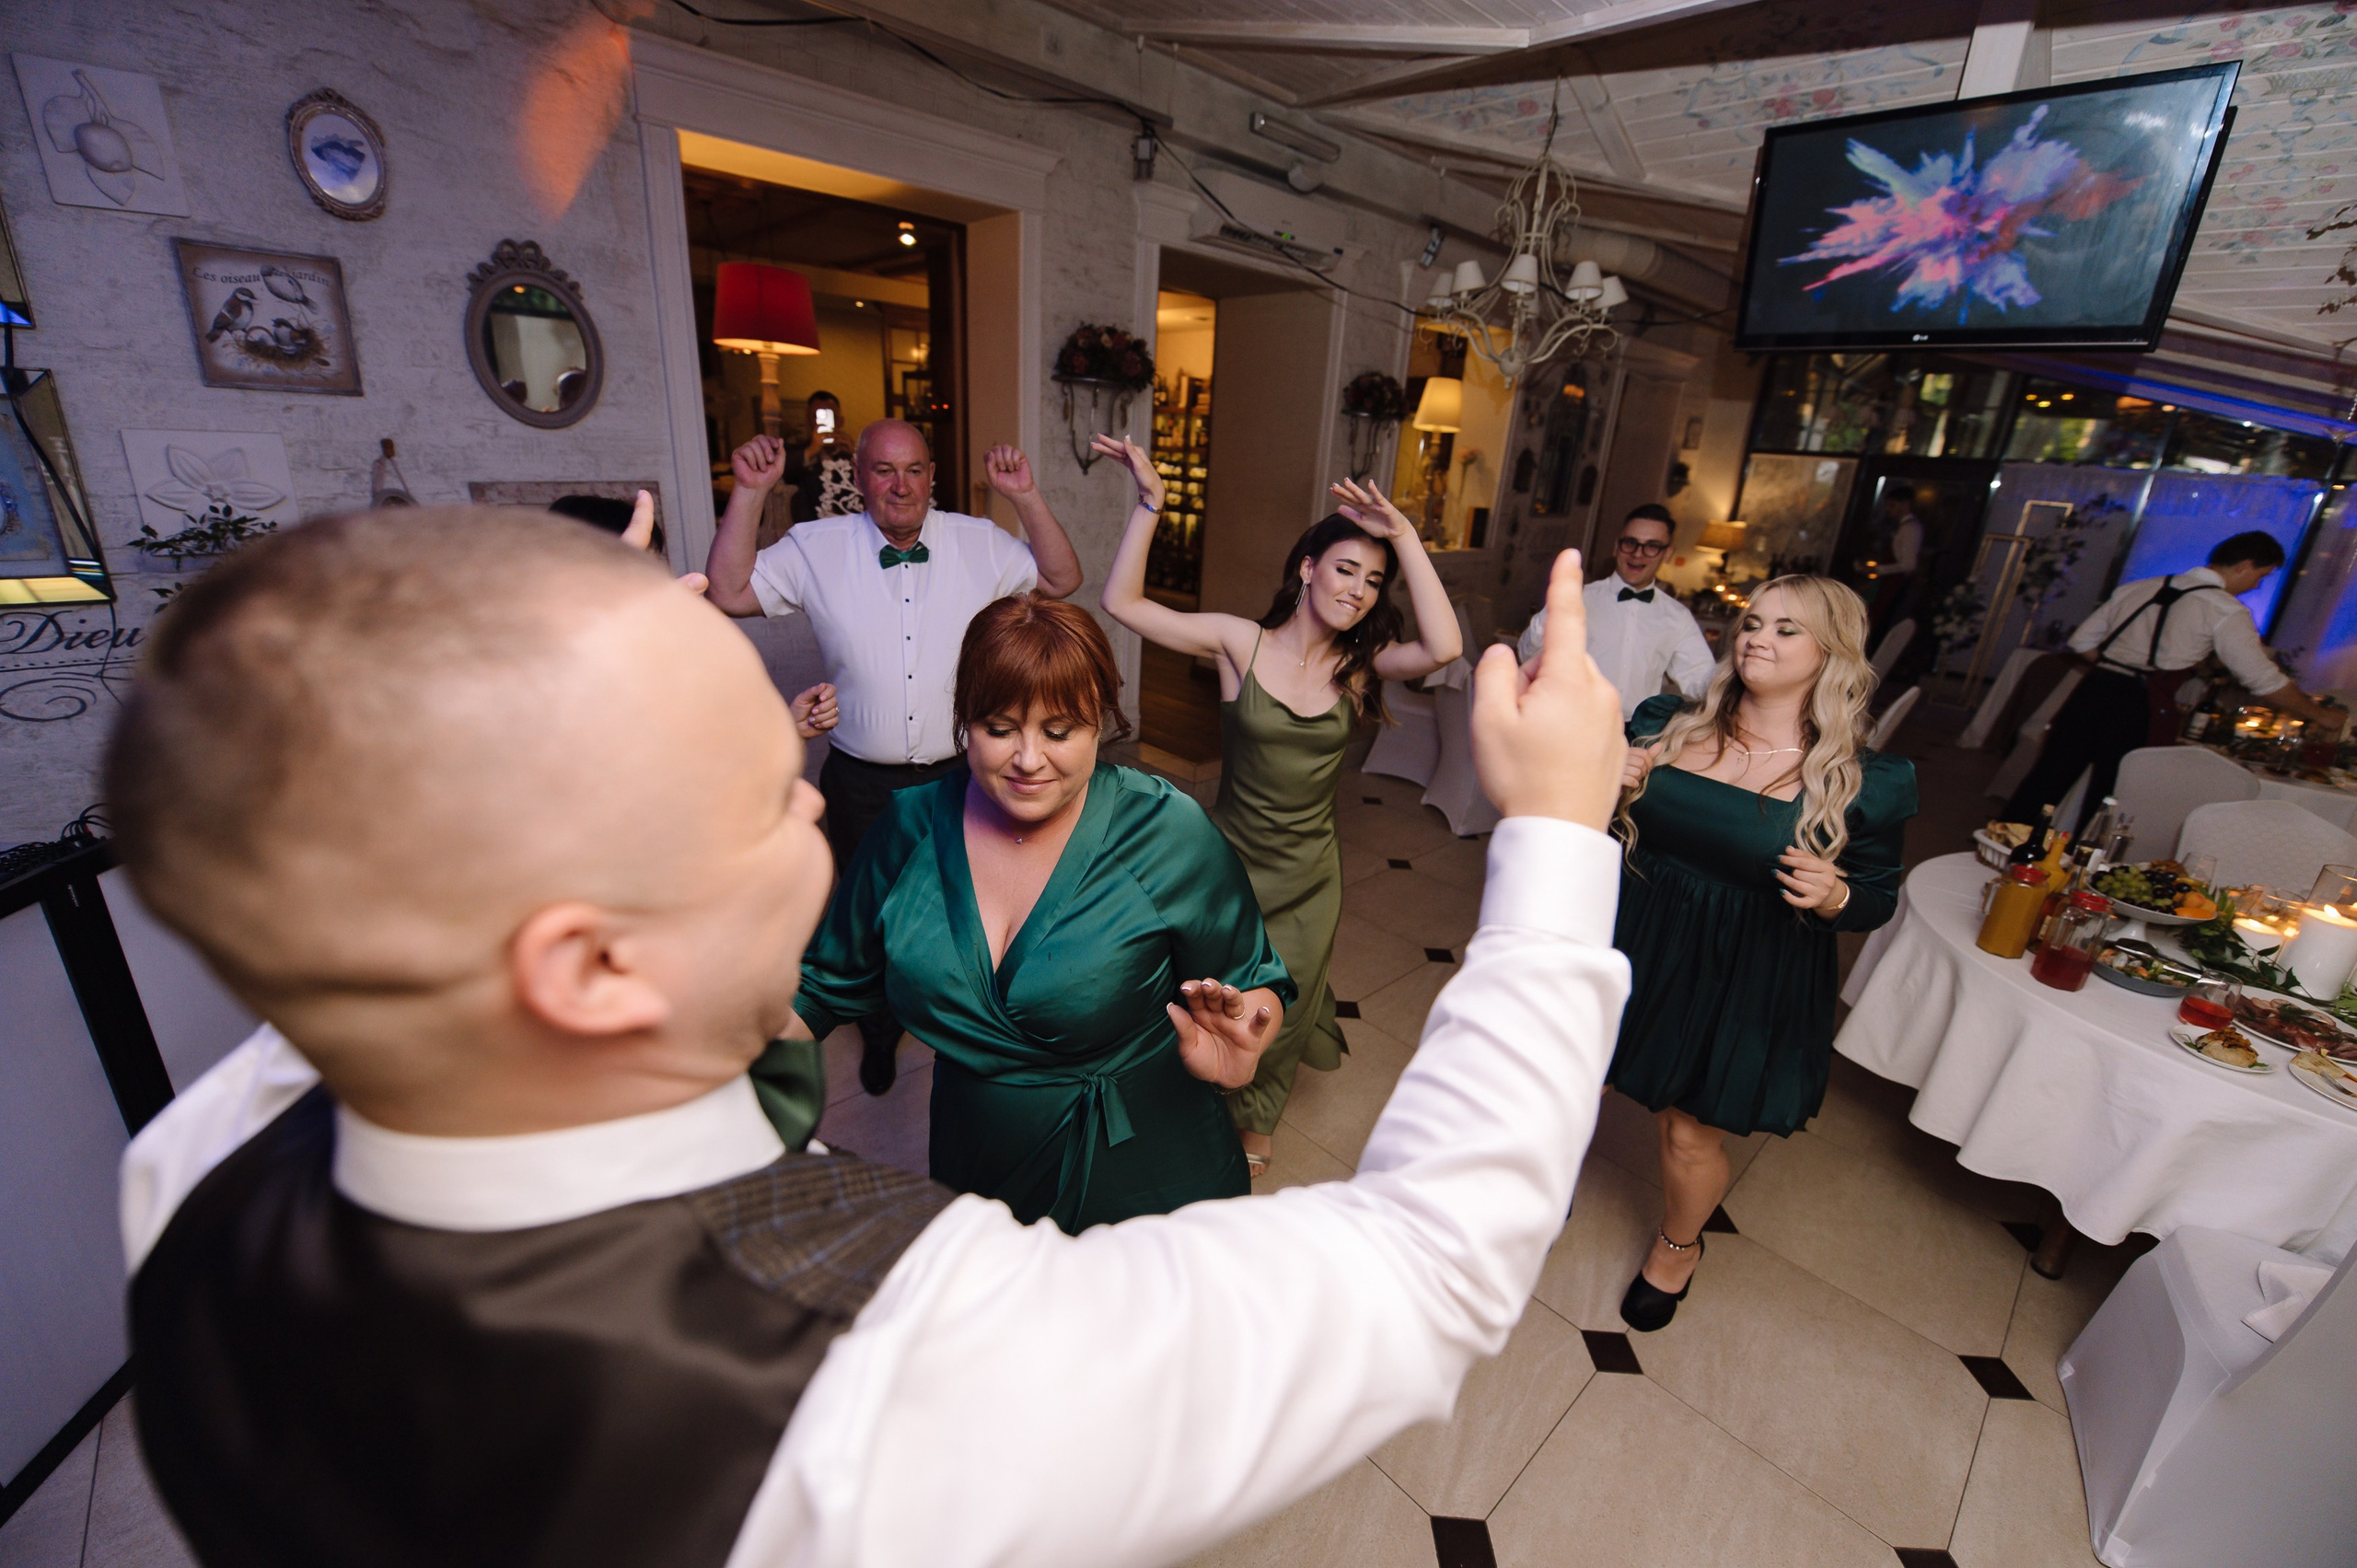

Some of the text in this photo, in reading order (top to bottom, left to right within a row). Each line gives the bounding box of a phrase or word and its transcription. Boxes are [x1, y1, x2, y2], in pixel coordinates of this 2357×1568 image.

[192, 266, 216, 282] Les
[220, 273, 261, 285] oiseau
[0, 610, 145, 655] Dieu
